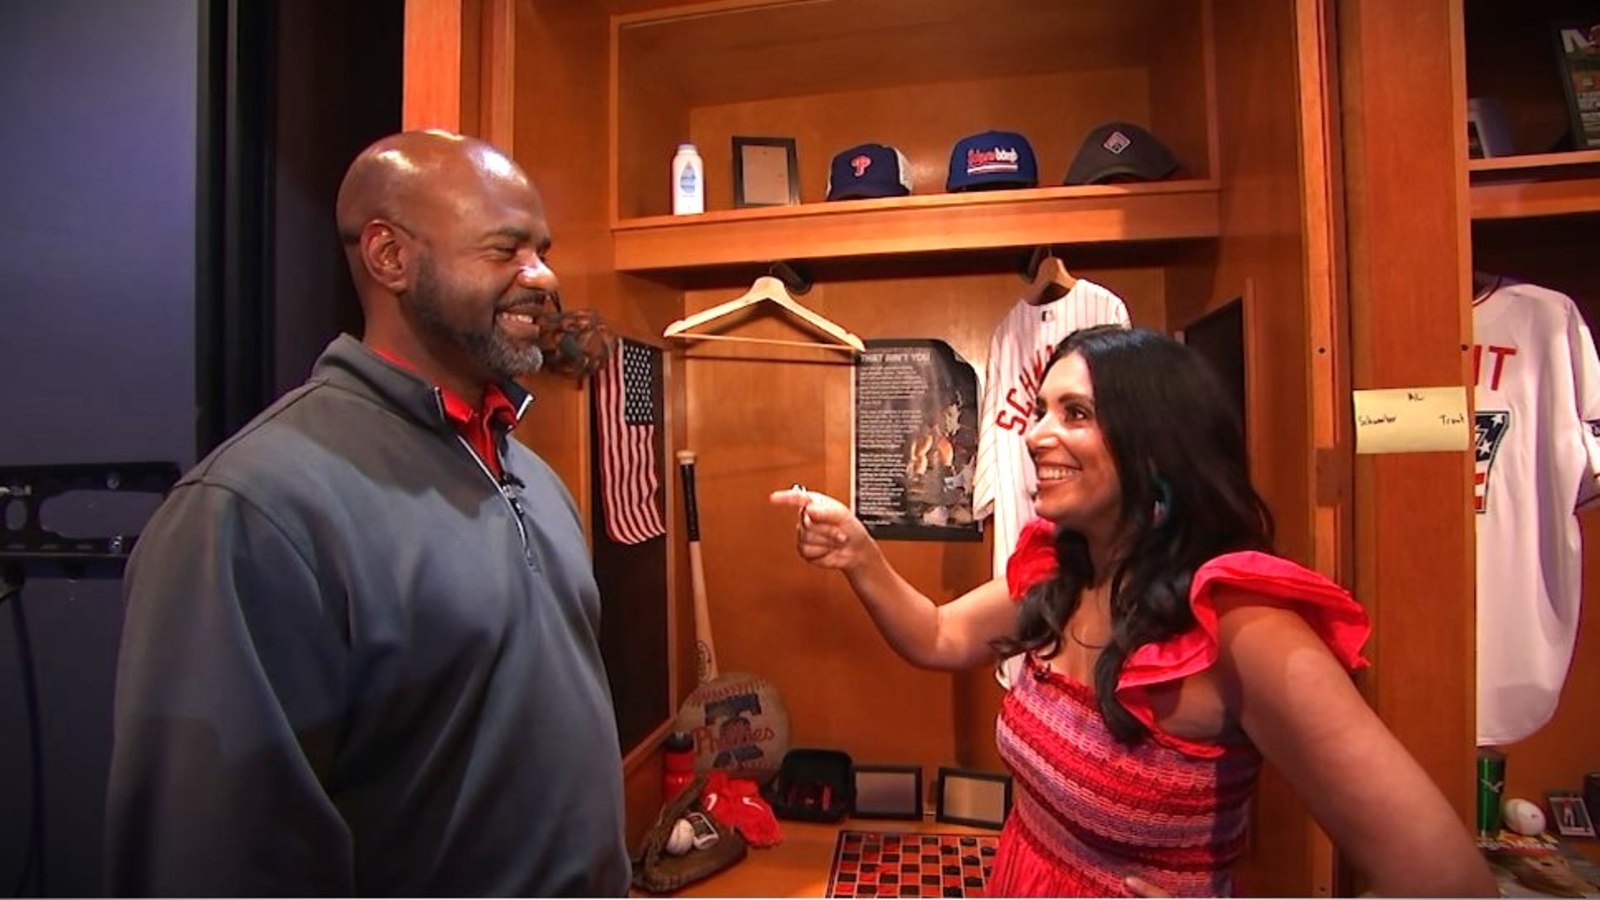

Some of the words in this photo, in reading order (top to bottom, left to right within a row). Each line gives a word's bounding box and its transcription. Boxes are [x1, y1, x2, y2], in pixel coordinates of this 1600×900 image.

[851, 155, 871, 177] P
[861, 353, 883, 362] THAT
[885, 353, 908, 362] AIN'T
[911, 352, 931, 362] YOU
[995, 344, 1056, 435] SCHW
